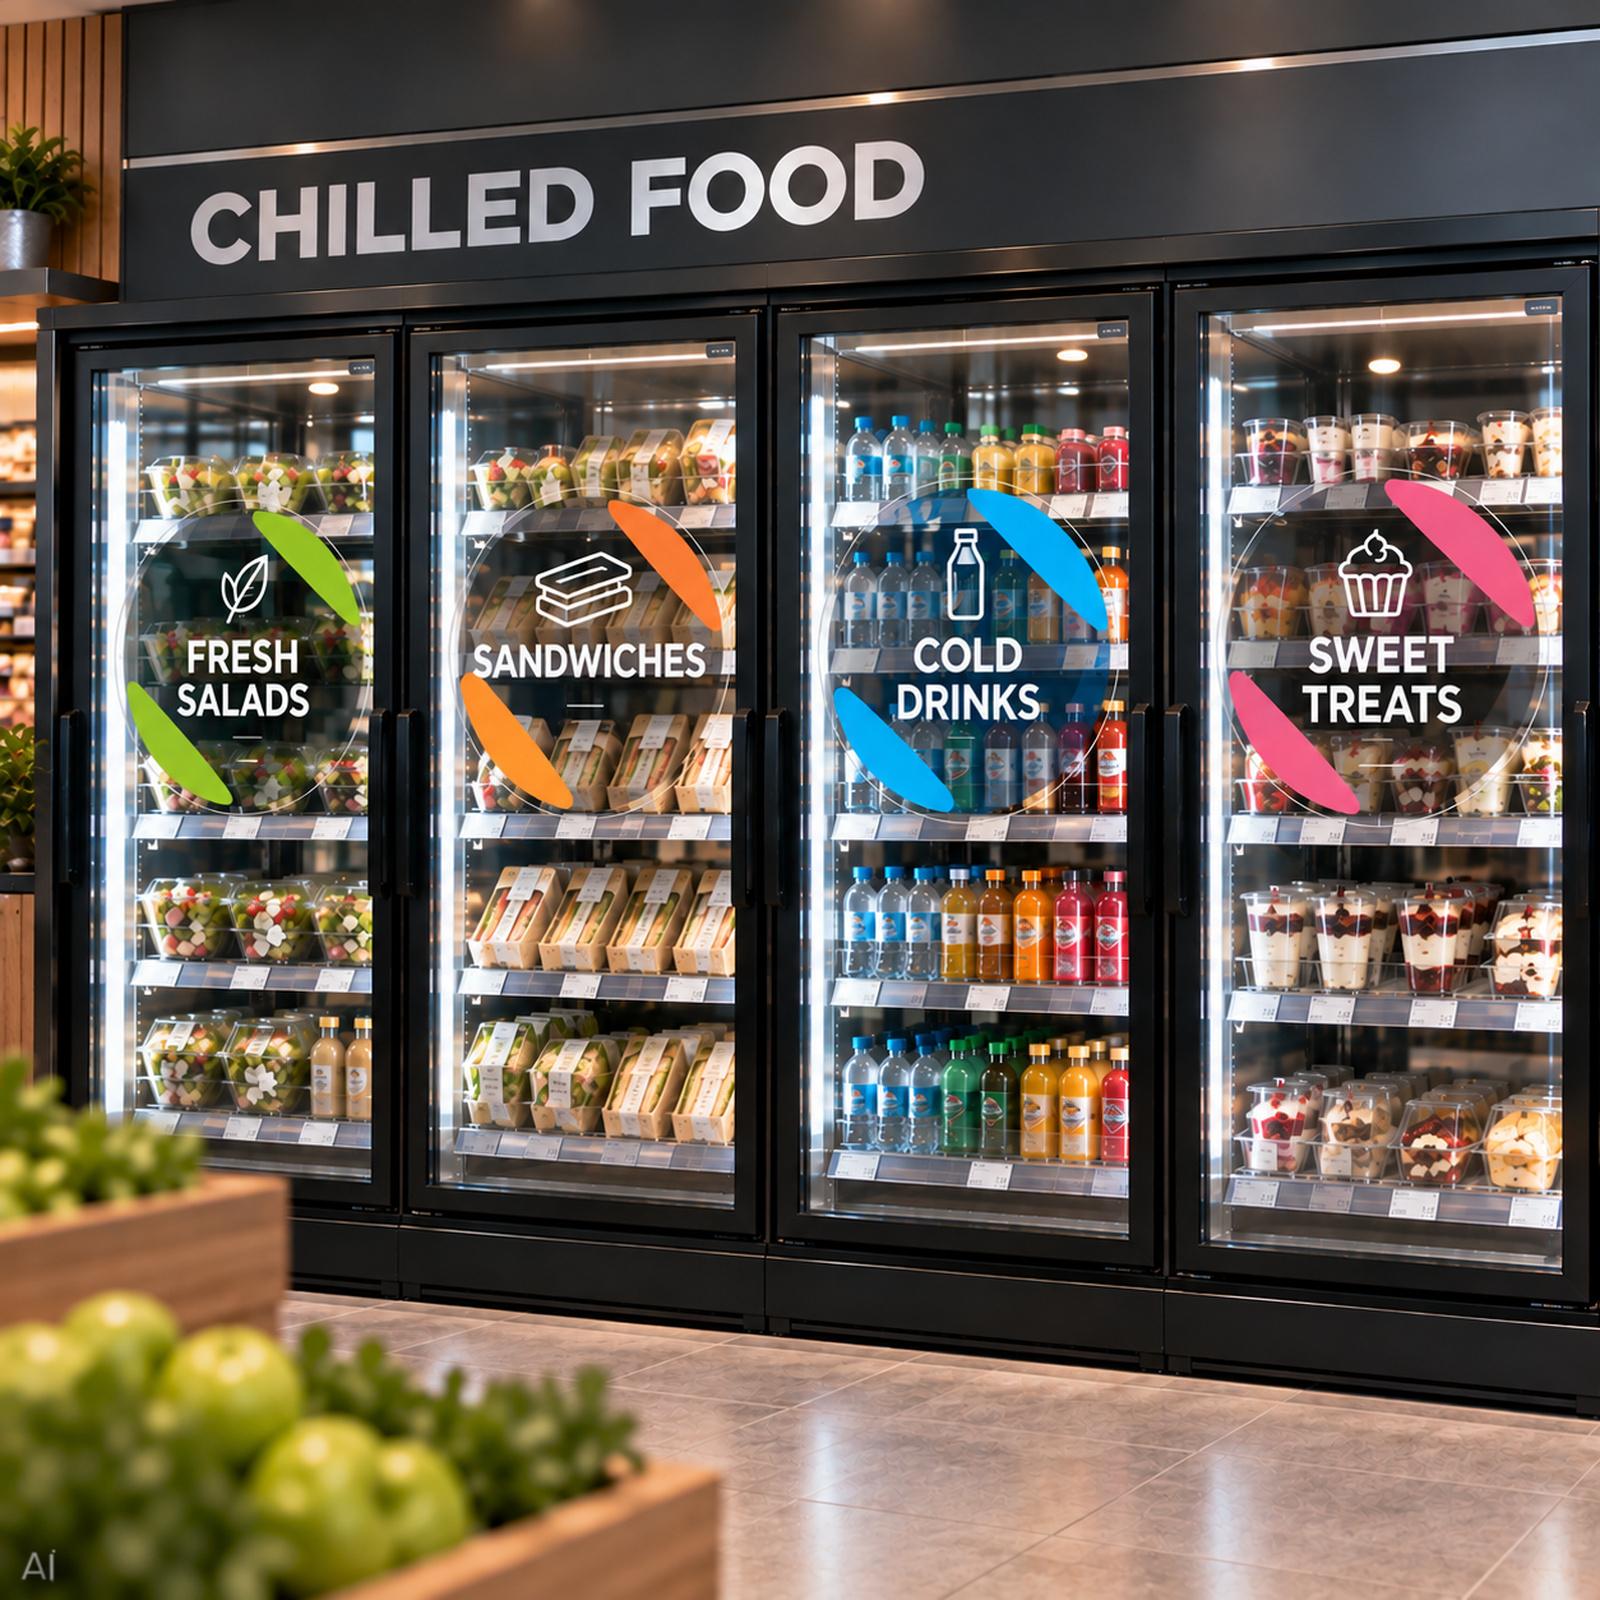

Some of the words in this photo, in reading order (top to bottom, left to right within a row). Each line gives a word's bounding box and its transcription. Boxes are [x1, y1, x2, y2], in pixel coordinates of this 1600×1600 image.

[190, 166, 594, 265] CHILLED
[631, 140, 925, 236] FOOD
[187, 638, 298, 674] FRESH
[473, 642, 706, 679] SANDWICHES
[913, 637, 1023, 674] COLD
[1308, 635, 1455, 674] SWEET
[177, 682, 310, 718] SALADS
[897, 683, 1041, 721] DRINKS
[1302, 684, 1462, 724] TREATS
